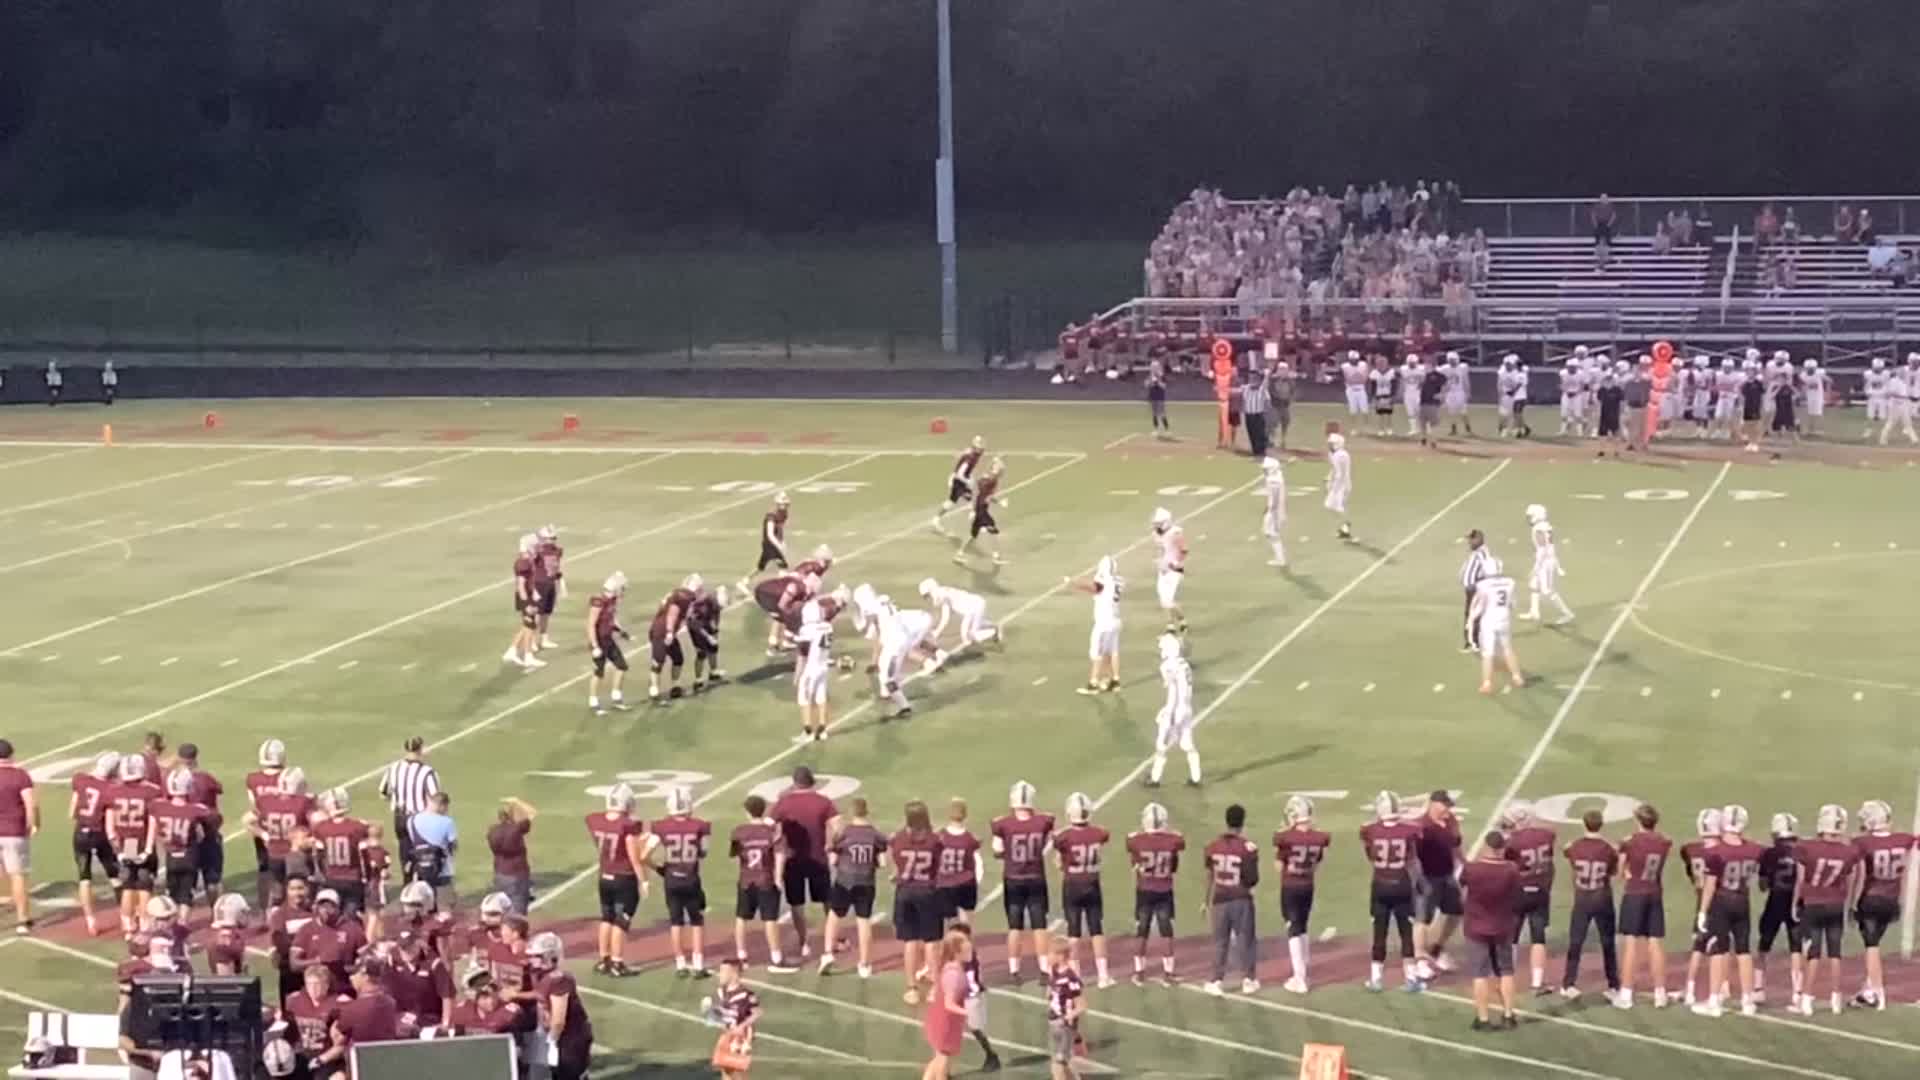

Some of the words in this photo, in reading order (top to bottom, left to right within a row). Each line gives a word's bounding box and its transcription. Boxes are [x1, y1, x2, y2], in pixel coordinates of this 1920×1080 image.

[1496, 589, 1507, 607] 3
[80, 787, 100, 817] 3
[115, 798, 145, 828] 22
[159, 816, 190, 842] 34
[326, 836, 350, 866] 10
[594, 831, 619, 861] 77
[666, 833, 697, 863] 26
[1011, 832, 1043, 862] 60
[1068, 843, 1100, 874] 30
[1373, 838, 1407, 869] 33
[900, 849, 932, 880] 72
[1139, 850, 1172, 878] 20
[1811, 857, 1845, 888] 17
